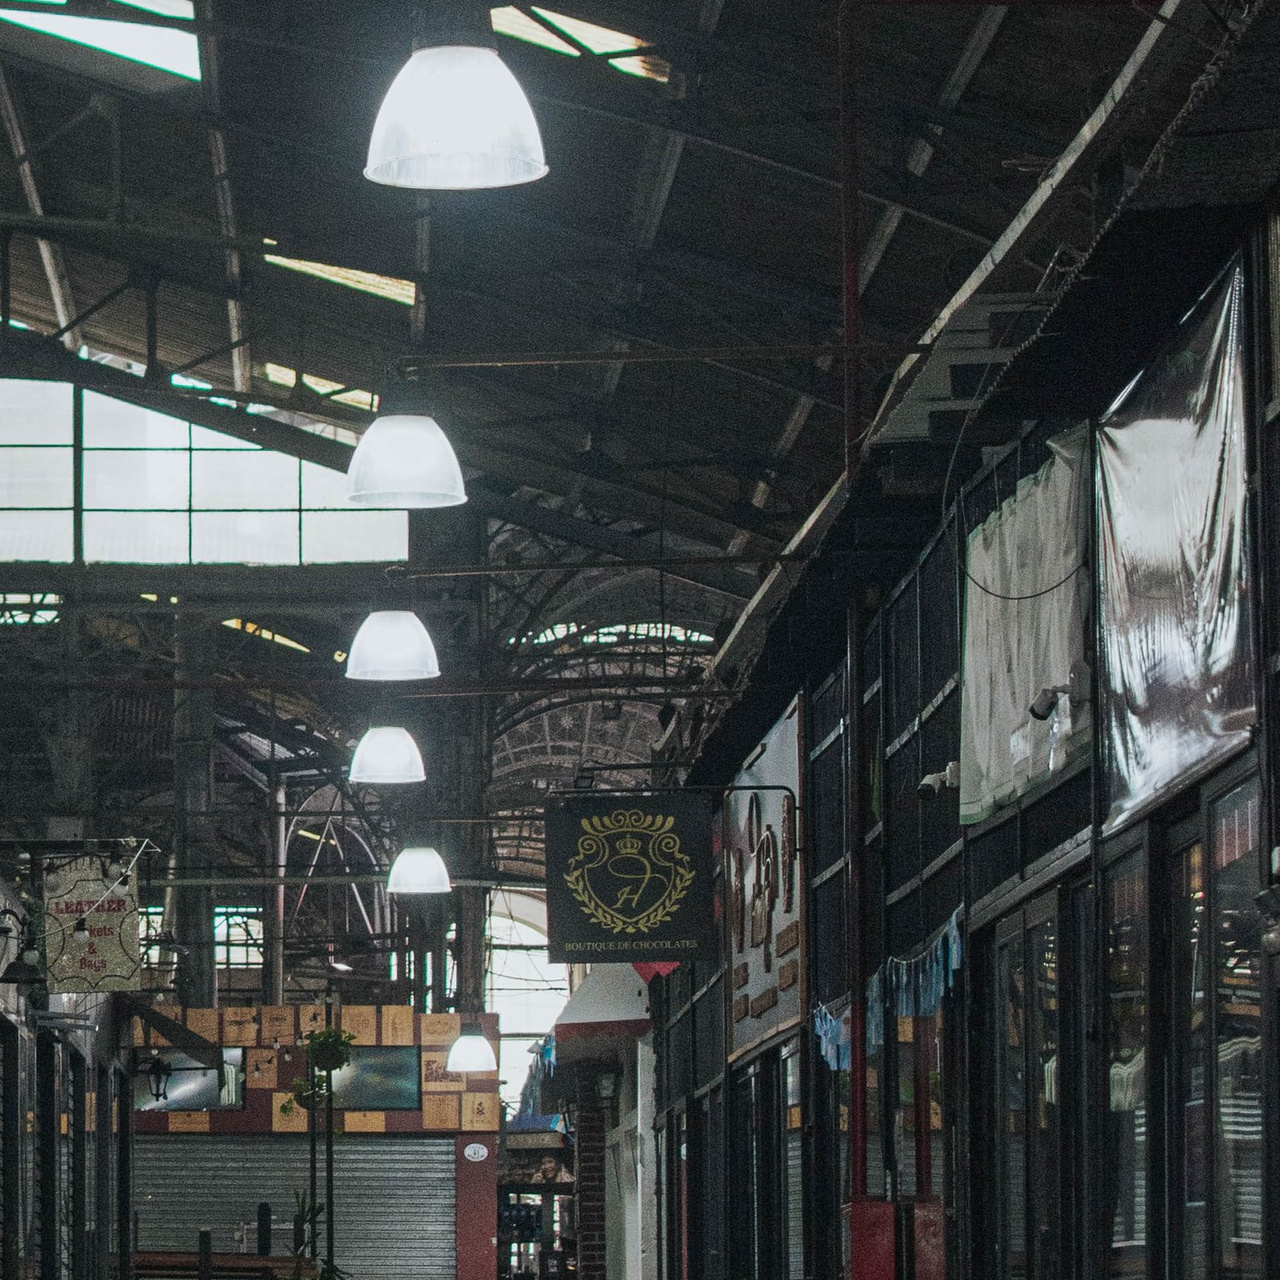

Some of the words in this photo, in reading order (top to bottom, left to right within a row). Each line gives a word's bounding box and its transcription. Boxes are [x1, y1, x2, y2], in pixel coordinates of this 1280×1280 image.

[88, 942, 97, 954] &
[565, 941, 616, 952] BOUTIQUE
[617, 941, 632, 950] DE
[633, 939, 698, 950] CHOCOLATES
[80, 957, 106, 972] Bags
